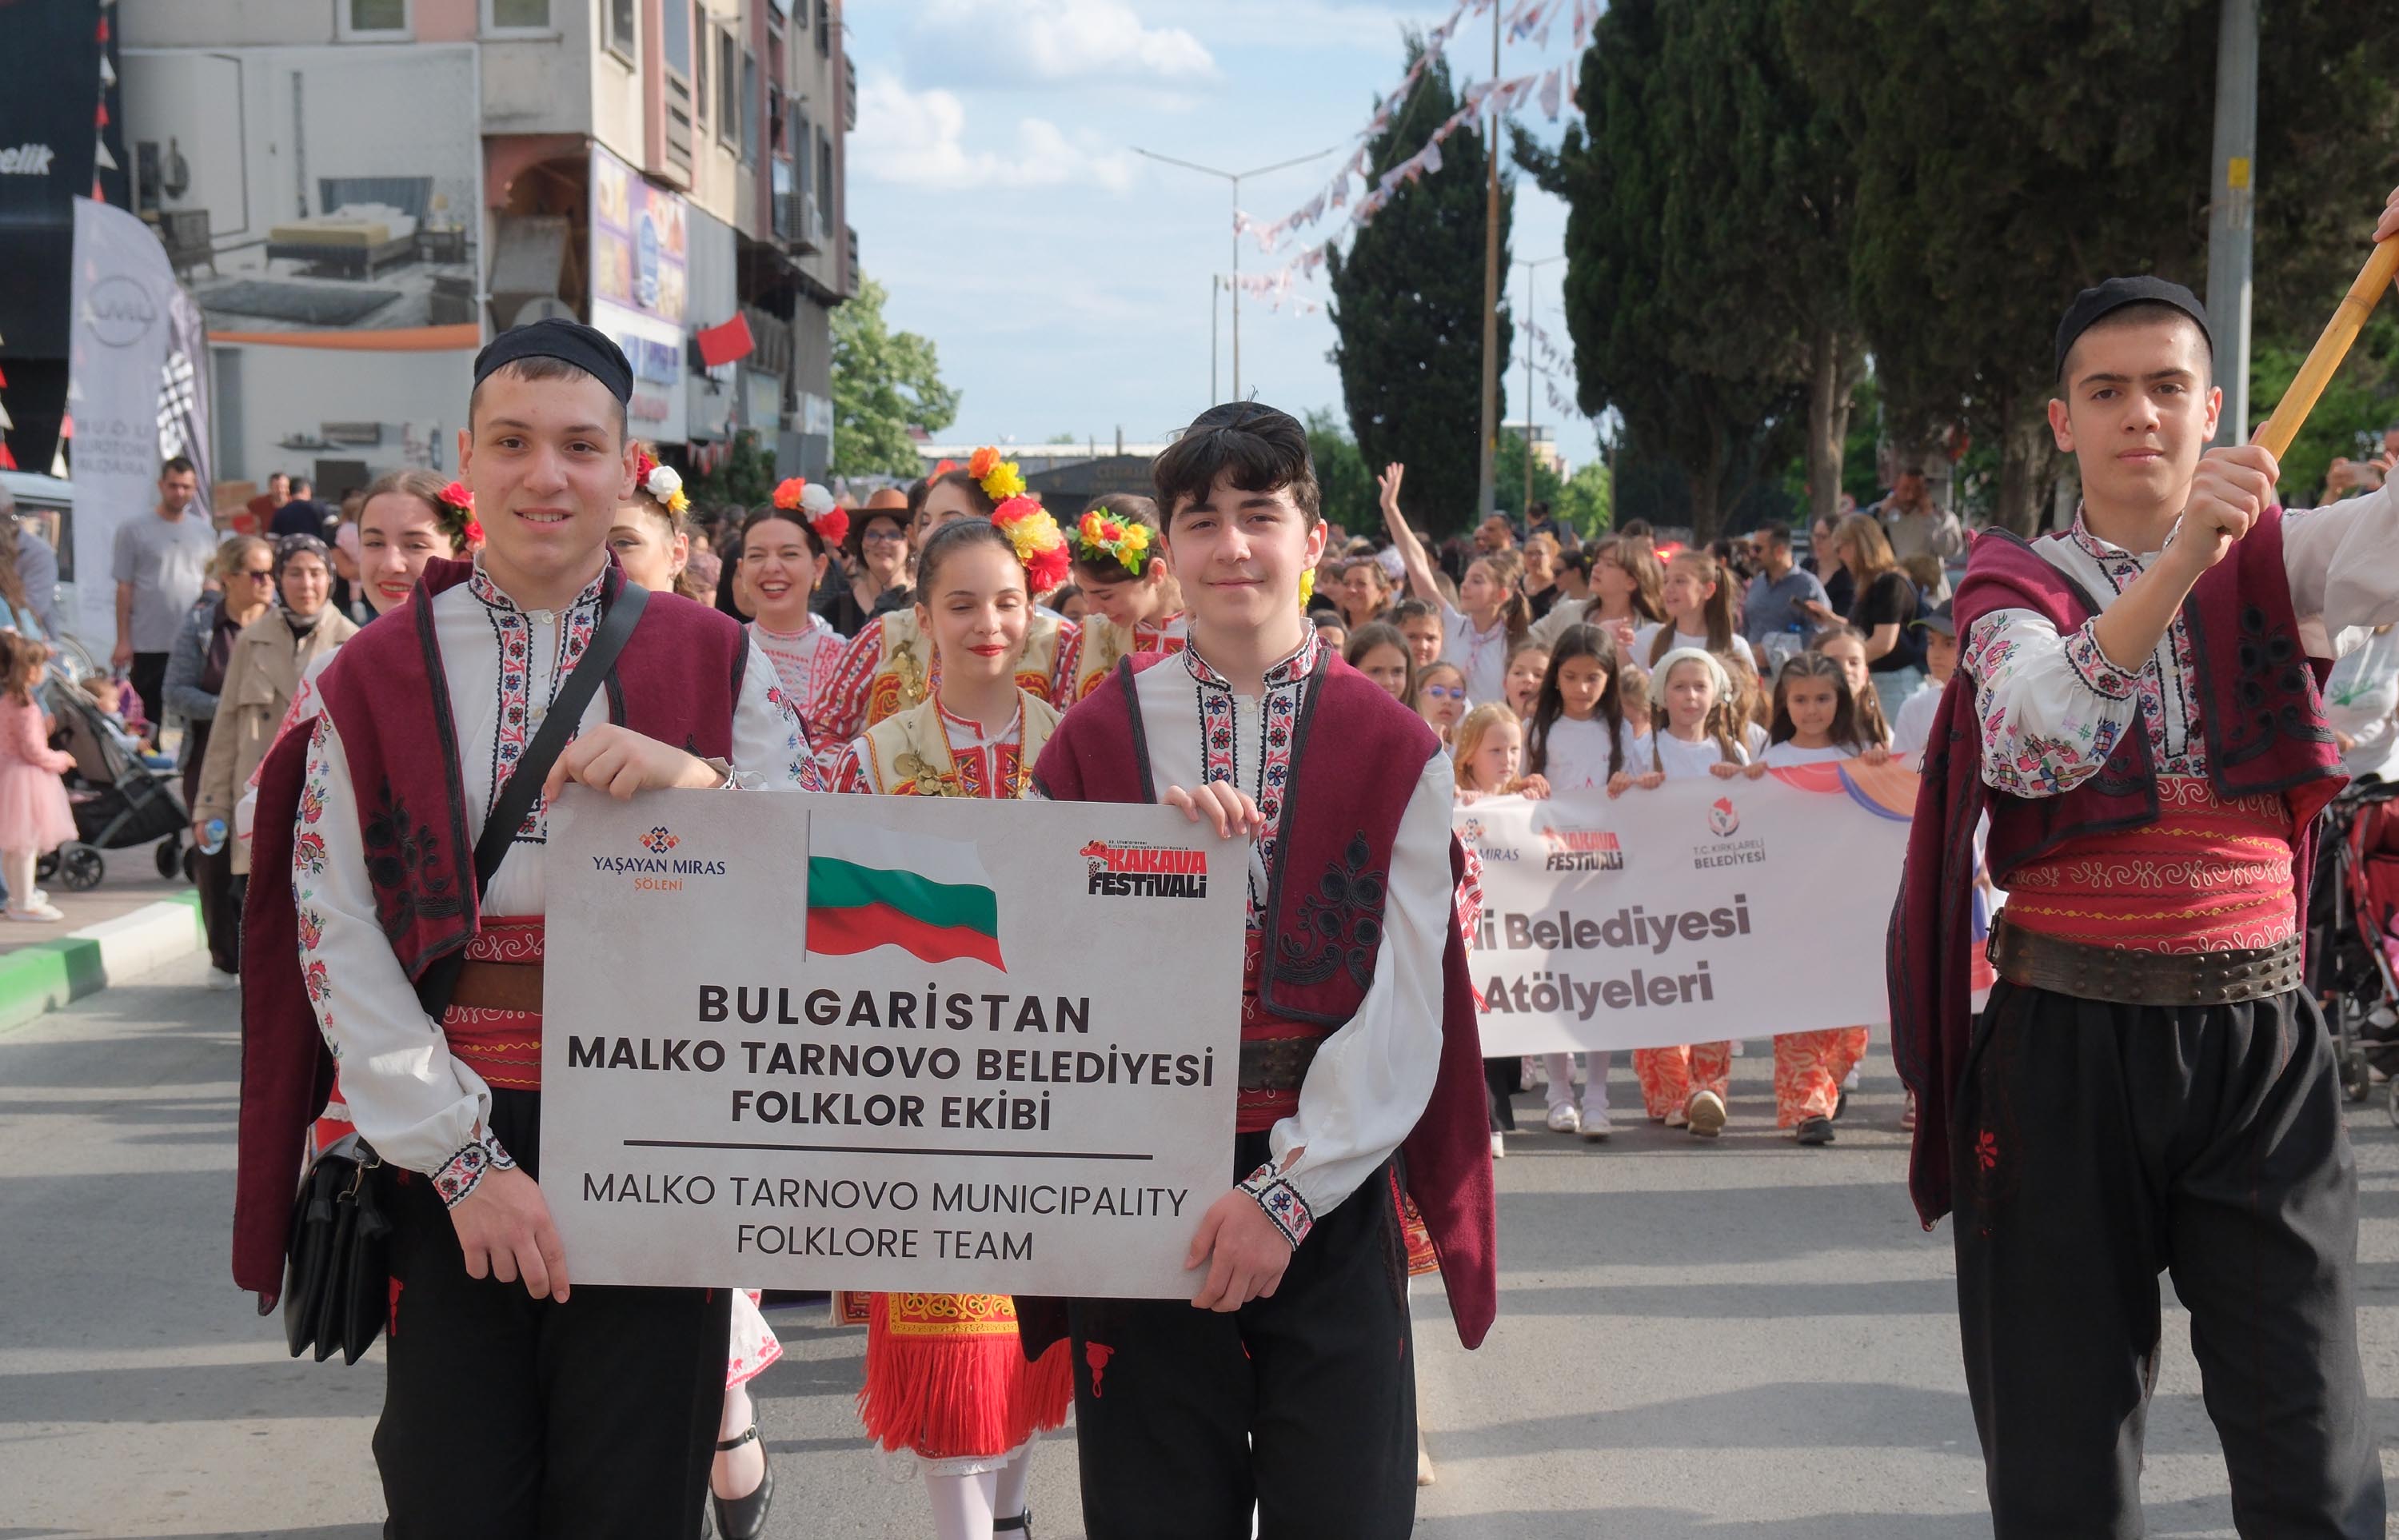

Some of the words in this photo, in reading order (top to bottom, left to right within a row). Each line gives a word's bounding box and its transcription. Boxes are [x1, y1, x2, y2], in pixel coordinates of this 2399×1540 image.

[593, 856, 668, 876] YAŞAYAN
[1107, 849, 1207, 874] KAKAVA
[634, 877, 683, 892] ŞÖLENİ
[1504, 894, 1751, 955] Belediyesi
[699, 982, 1090, 1034] BULGARİSTAN
[1482, 960, 1714, 1021] Atölyeleri
[568, 1035, 725, 1072] MALKO
[740, 1041, 960, 1079] TARNOVO
[976, 1043, 1213, 1087] BELEDİYESİ
[732, 1090, 924, 1127] FOLKLOR
[940, 1089, 1050, 1131] EKİBİ
[583, 1172, 716, 1205] MALKO
[729, 1176, 918, 1211] TARNOVO
[932, 1183, 1188, 1217] MUNICIPALITY
[737, 1224, 919, 1258] FOLKLORE
[933, 1230, 1032, 1261] TEAM
